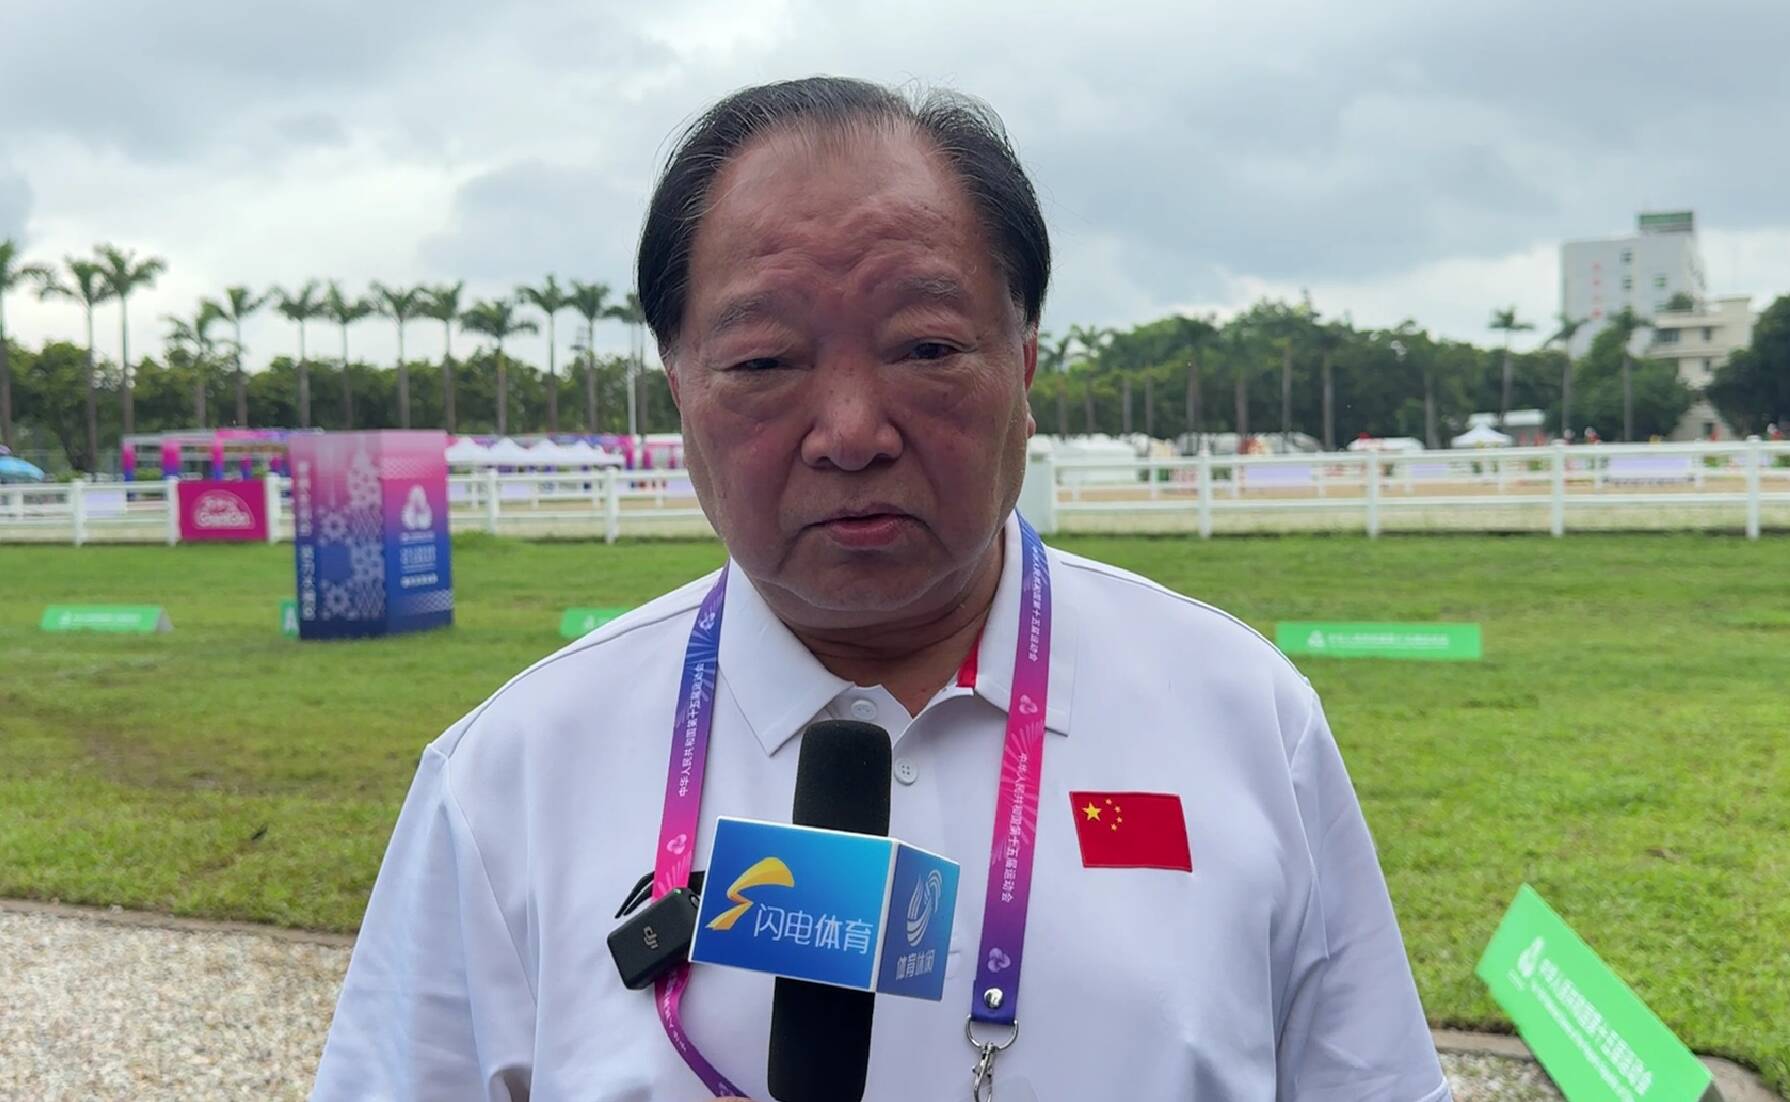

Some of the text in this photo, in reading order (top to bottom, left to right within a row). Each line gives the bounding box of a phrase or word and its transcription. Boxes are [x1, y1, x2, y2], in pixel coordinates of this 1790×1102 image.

[753, 903, 874, 954] 闪电体育
[896, 949, 936, 980] 体育休闲
